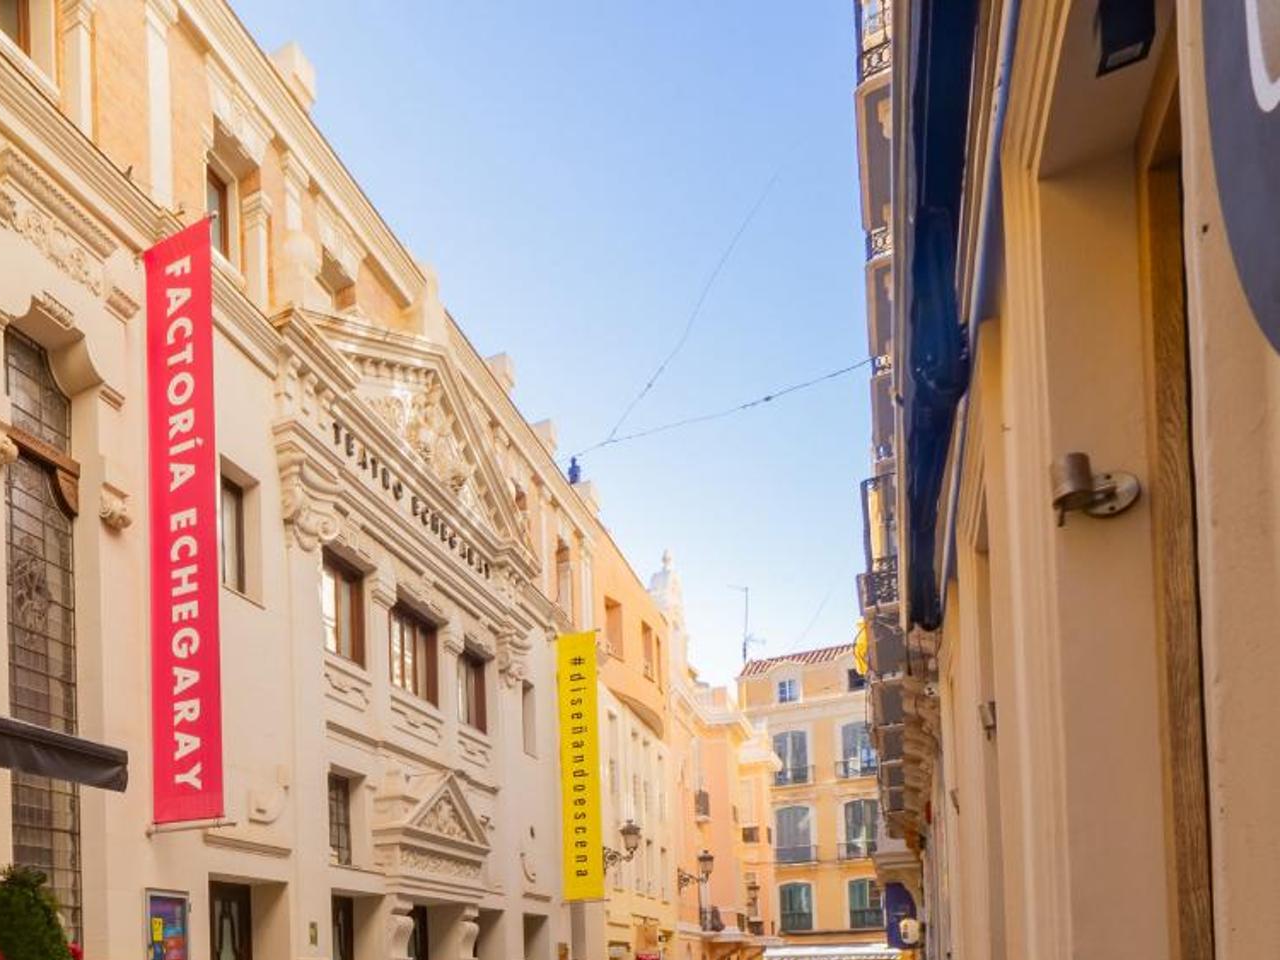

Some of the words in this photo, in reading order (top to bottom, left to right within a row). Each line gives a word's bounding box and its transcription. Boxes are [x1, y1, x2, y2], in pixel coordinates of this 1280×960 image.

[165, 256, 204, 492] FACTORÍA
[332, 422, 403, 501] TEATRO
[411, 496, 490, 579] ECHEGARAY
[170, 507, 202, 791] ECHEGARAY
[570, 656, 588, 877] #diseñandoescena
